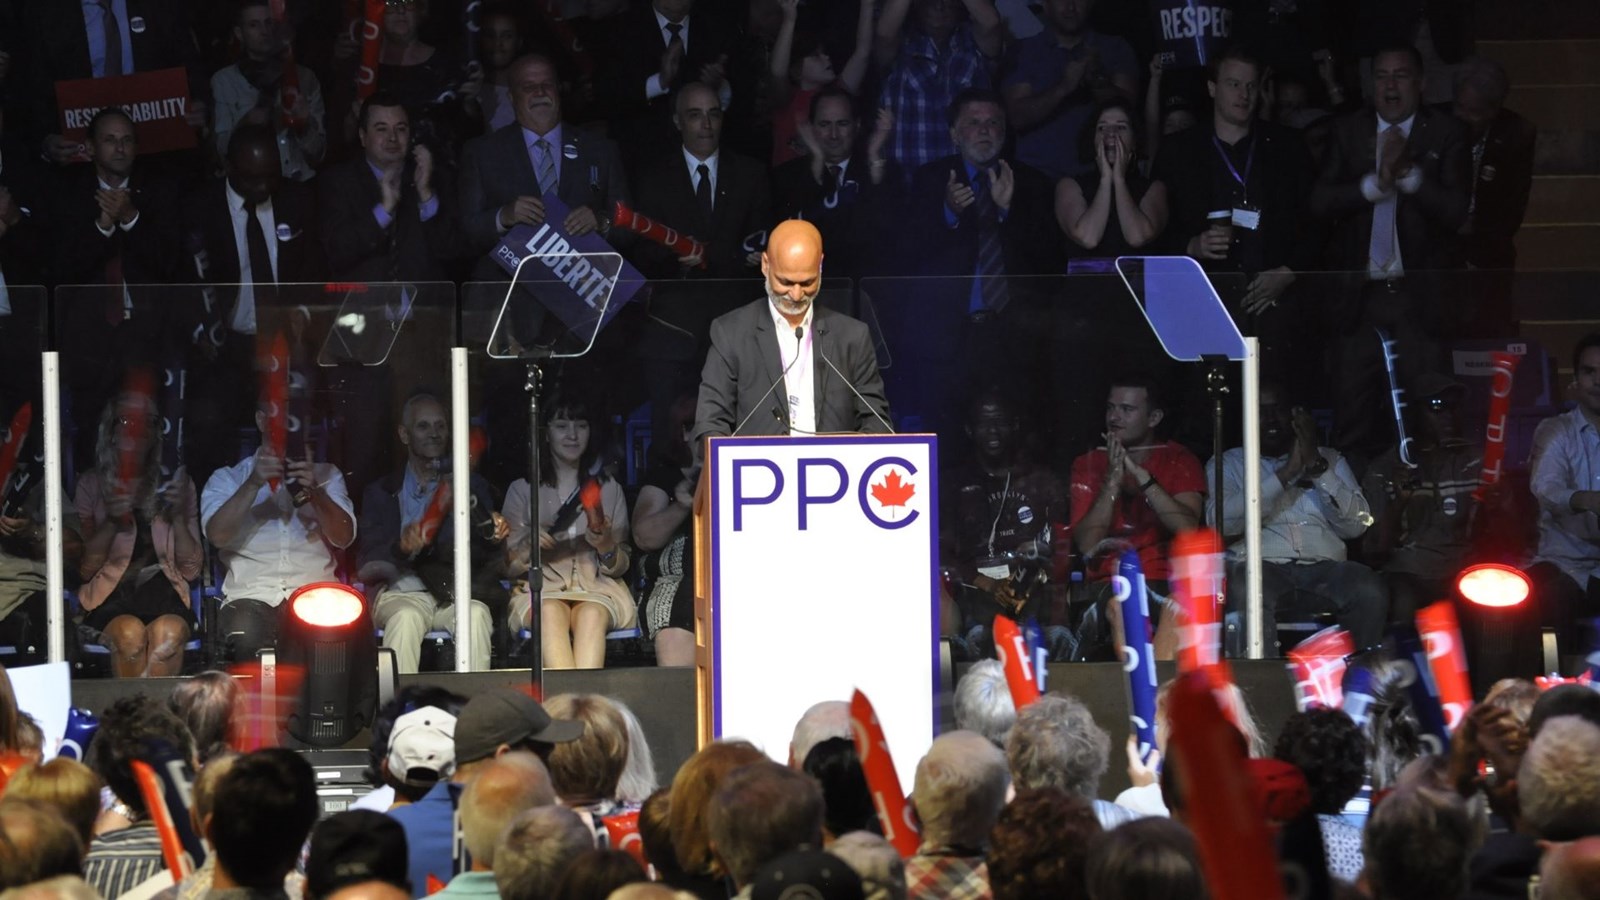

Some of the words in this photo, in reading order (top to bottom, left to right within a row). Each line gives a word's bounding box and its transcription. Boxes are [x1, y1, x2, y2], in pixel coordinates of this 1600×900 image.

[1160, 5, 1232, 40] RESPEC
[64, 96, 186, 129] RESPSABILITY
[732, 456, 920, 531] PPC
